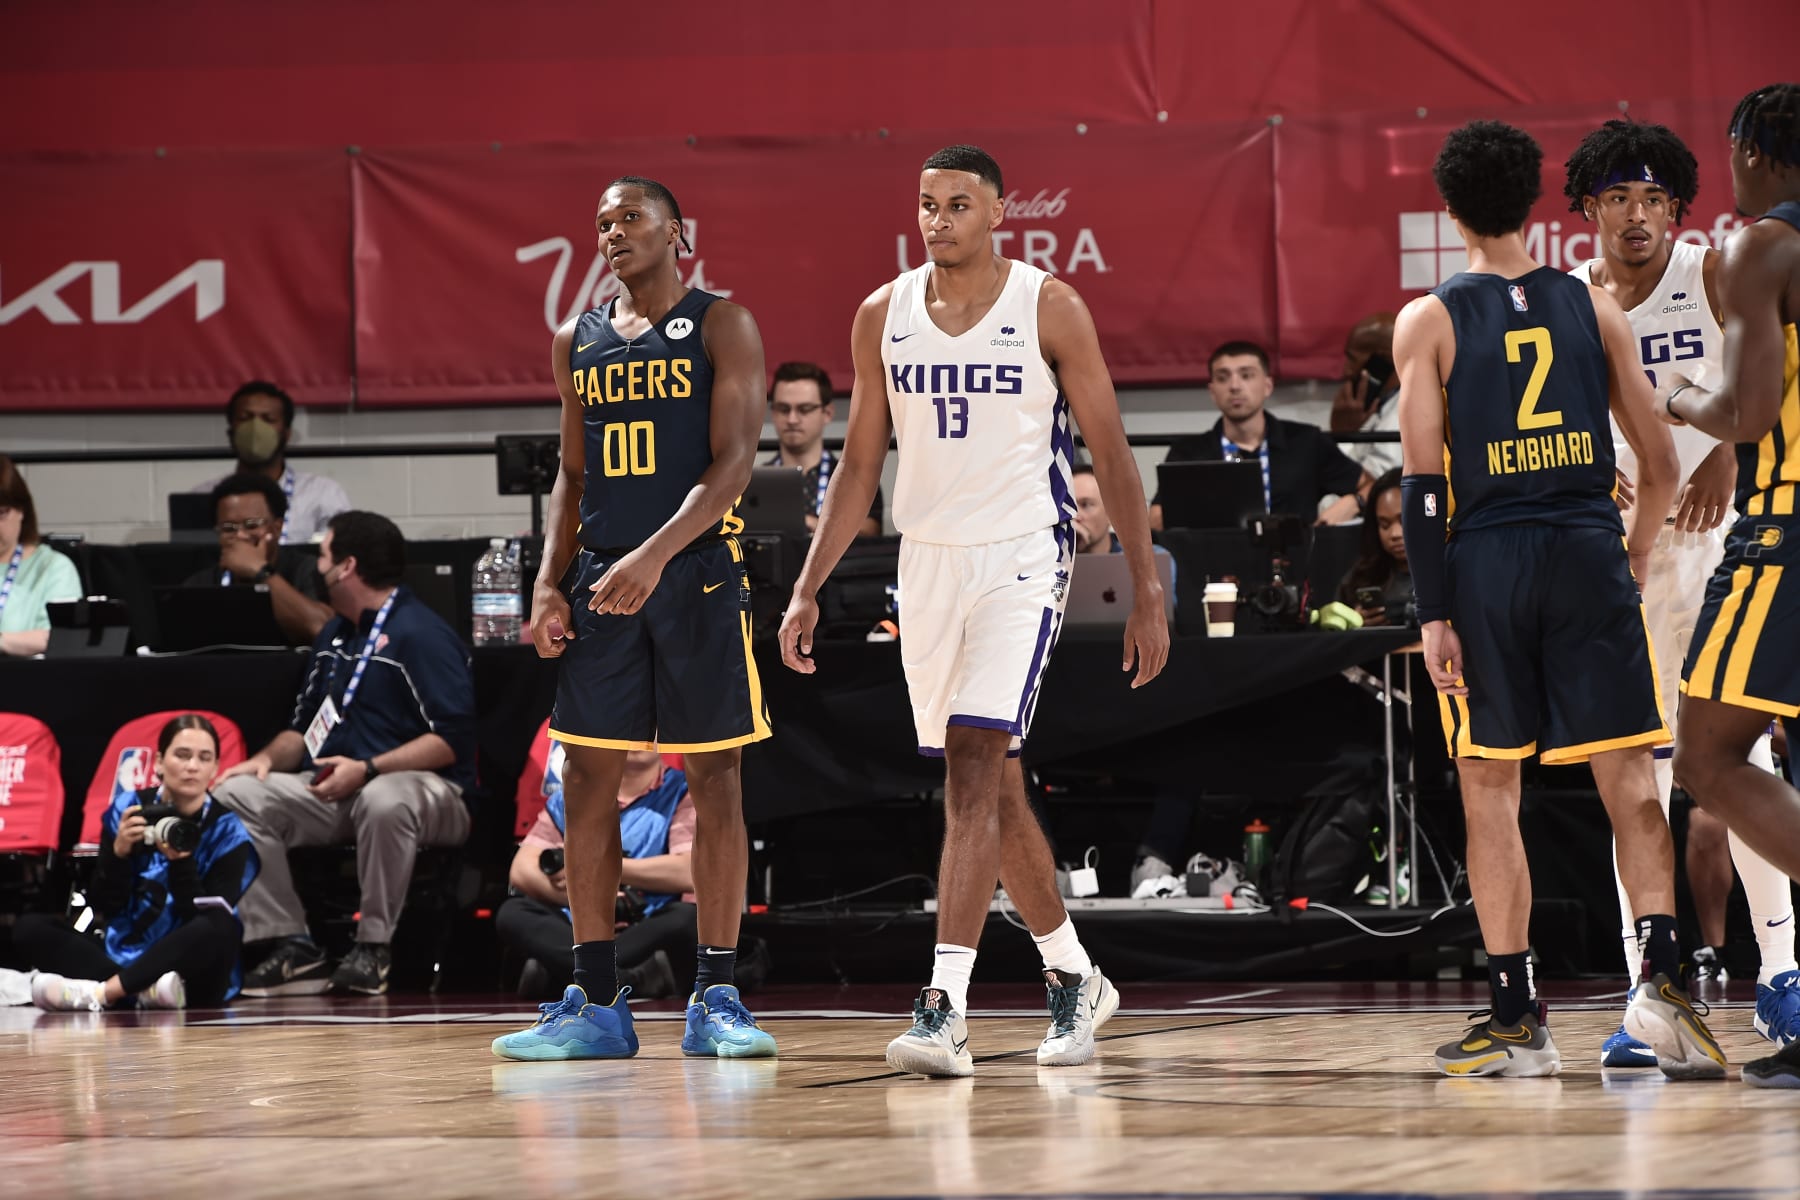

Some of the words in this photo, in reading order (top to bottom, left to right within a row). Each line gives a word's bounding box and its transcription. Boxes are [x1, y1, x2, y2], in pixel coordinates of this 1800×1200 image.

[1661, 302, 1698, 314] dialpad
[990, 338, 1025, 348] dialpad
[573, 358, 692, 407] PACERS
[890, 364, 1023, 394] KINGS
[1504, 326, 1563, 430] 2
[932, 397, 969, 439] 13
[603, 420, 656, 477] 00
[1487, 431, 1594, 475] NEMBHARD
